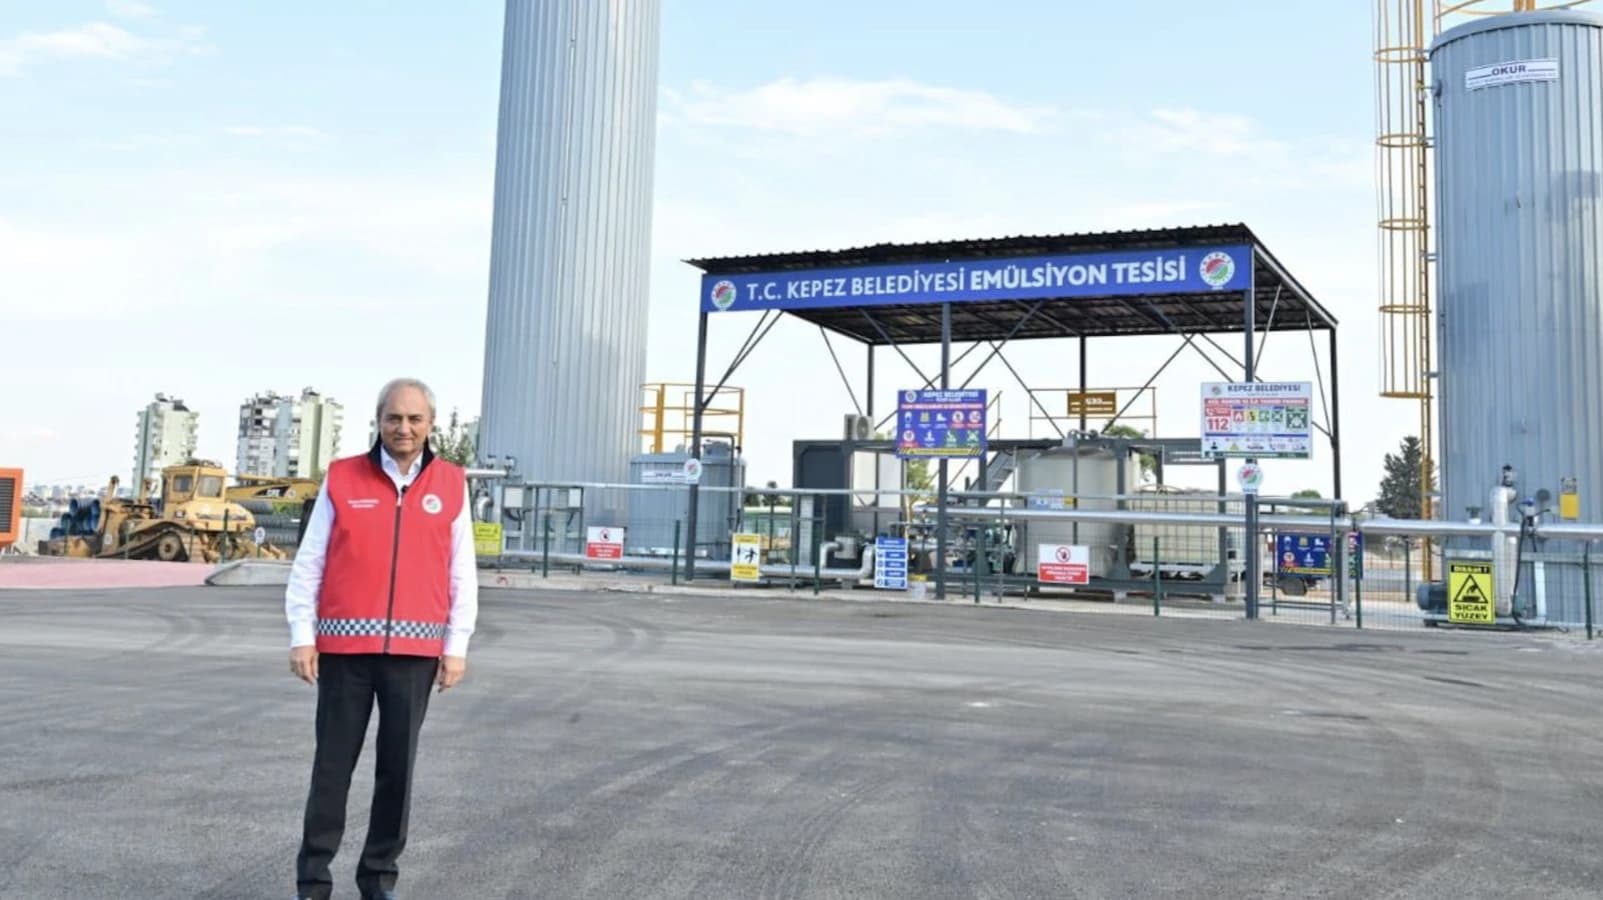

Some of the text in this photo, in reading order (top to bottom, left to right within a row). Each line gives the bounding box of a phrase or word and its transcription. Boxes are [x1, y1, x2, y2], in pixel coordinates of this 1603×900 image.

[1491, 65, 1527, 76] OKUR
[746, 255, 1186, 301] T.C. KEPEZ BELEDİYESİ EMÜLSİYON TESİSİ
[1207, 418, 1229, 431] 112
